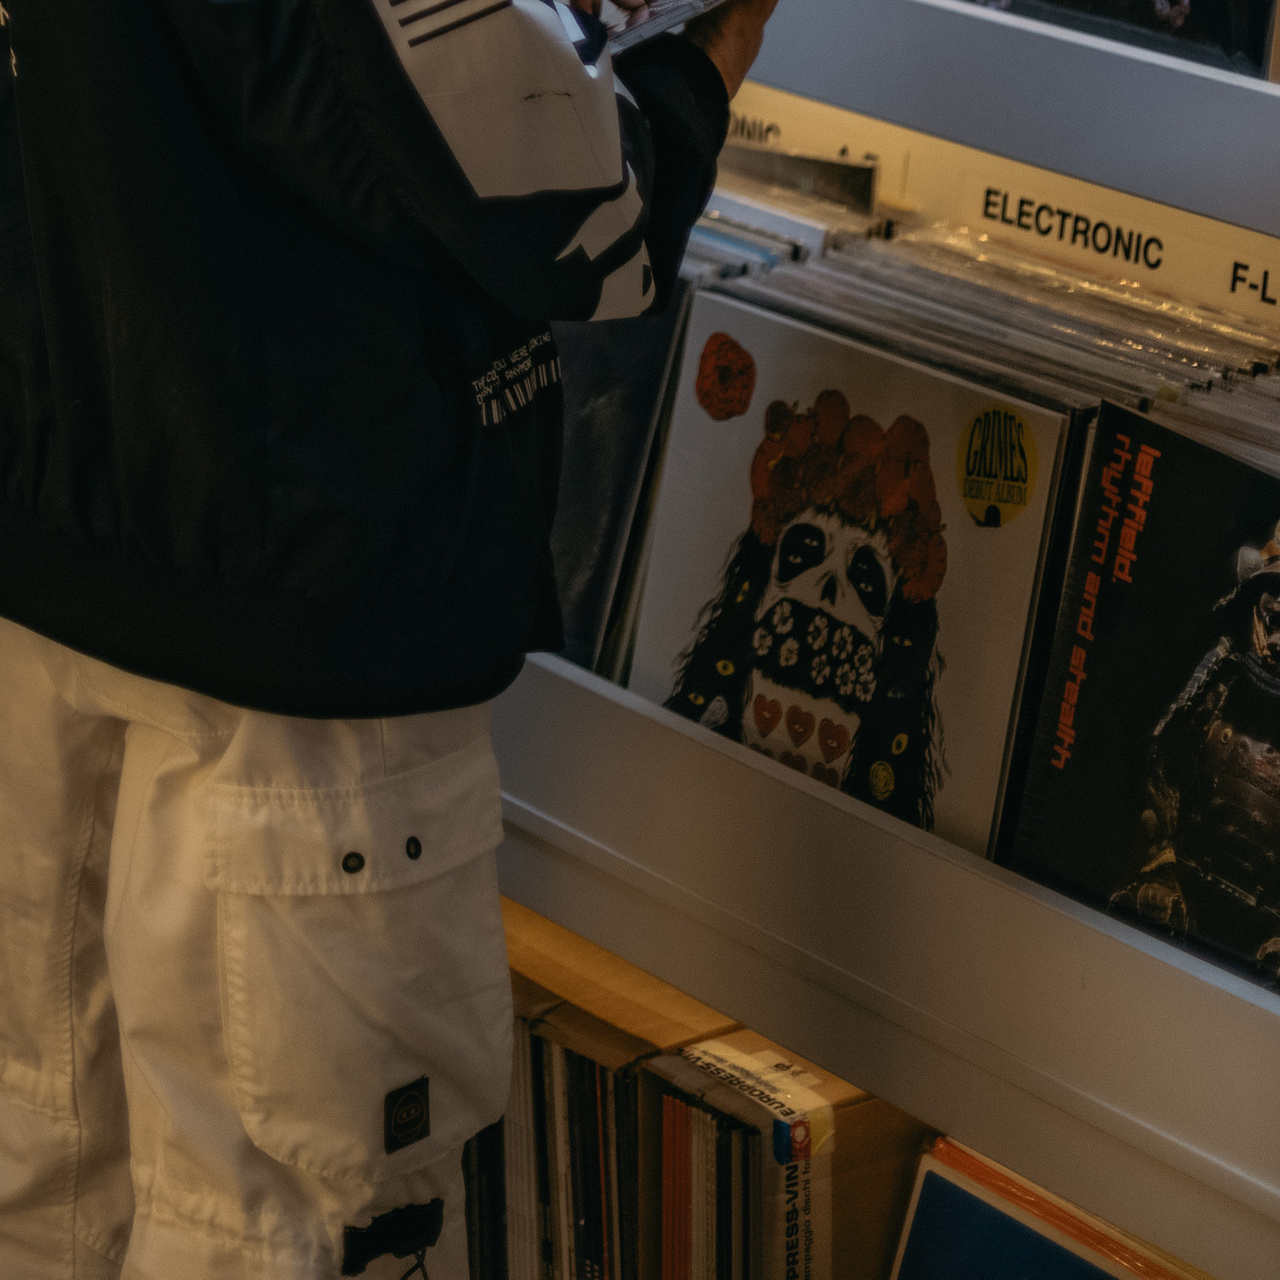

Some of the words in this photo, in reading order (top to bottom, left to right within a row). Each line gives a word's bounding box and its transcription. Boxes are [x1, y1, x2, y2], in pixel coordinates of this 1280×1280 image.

[983, 187, 1164, 270] ELECTRONIC
[1230, 261, 1277, 305] F-L
[964, 478, 993, 501] DEBUT
[995, 482, 1028, 506] ALBUM
[965, 409, 1028, 484] GRIMES
[1089, 432, 1132, 567] rhythm
[1110, 444, 1162, 584] leftfield.
[1079, 573, 1104, 642] and
[1049, 643, 1090, 771] stealth
[804, 1179, 813, 1216] dischi
